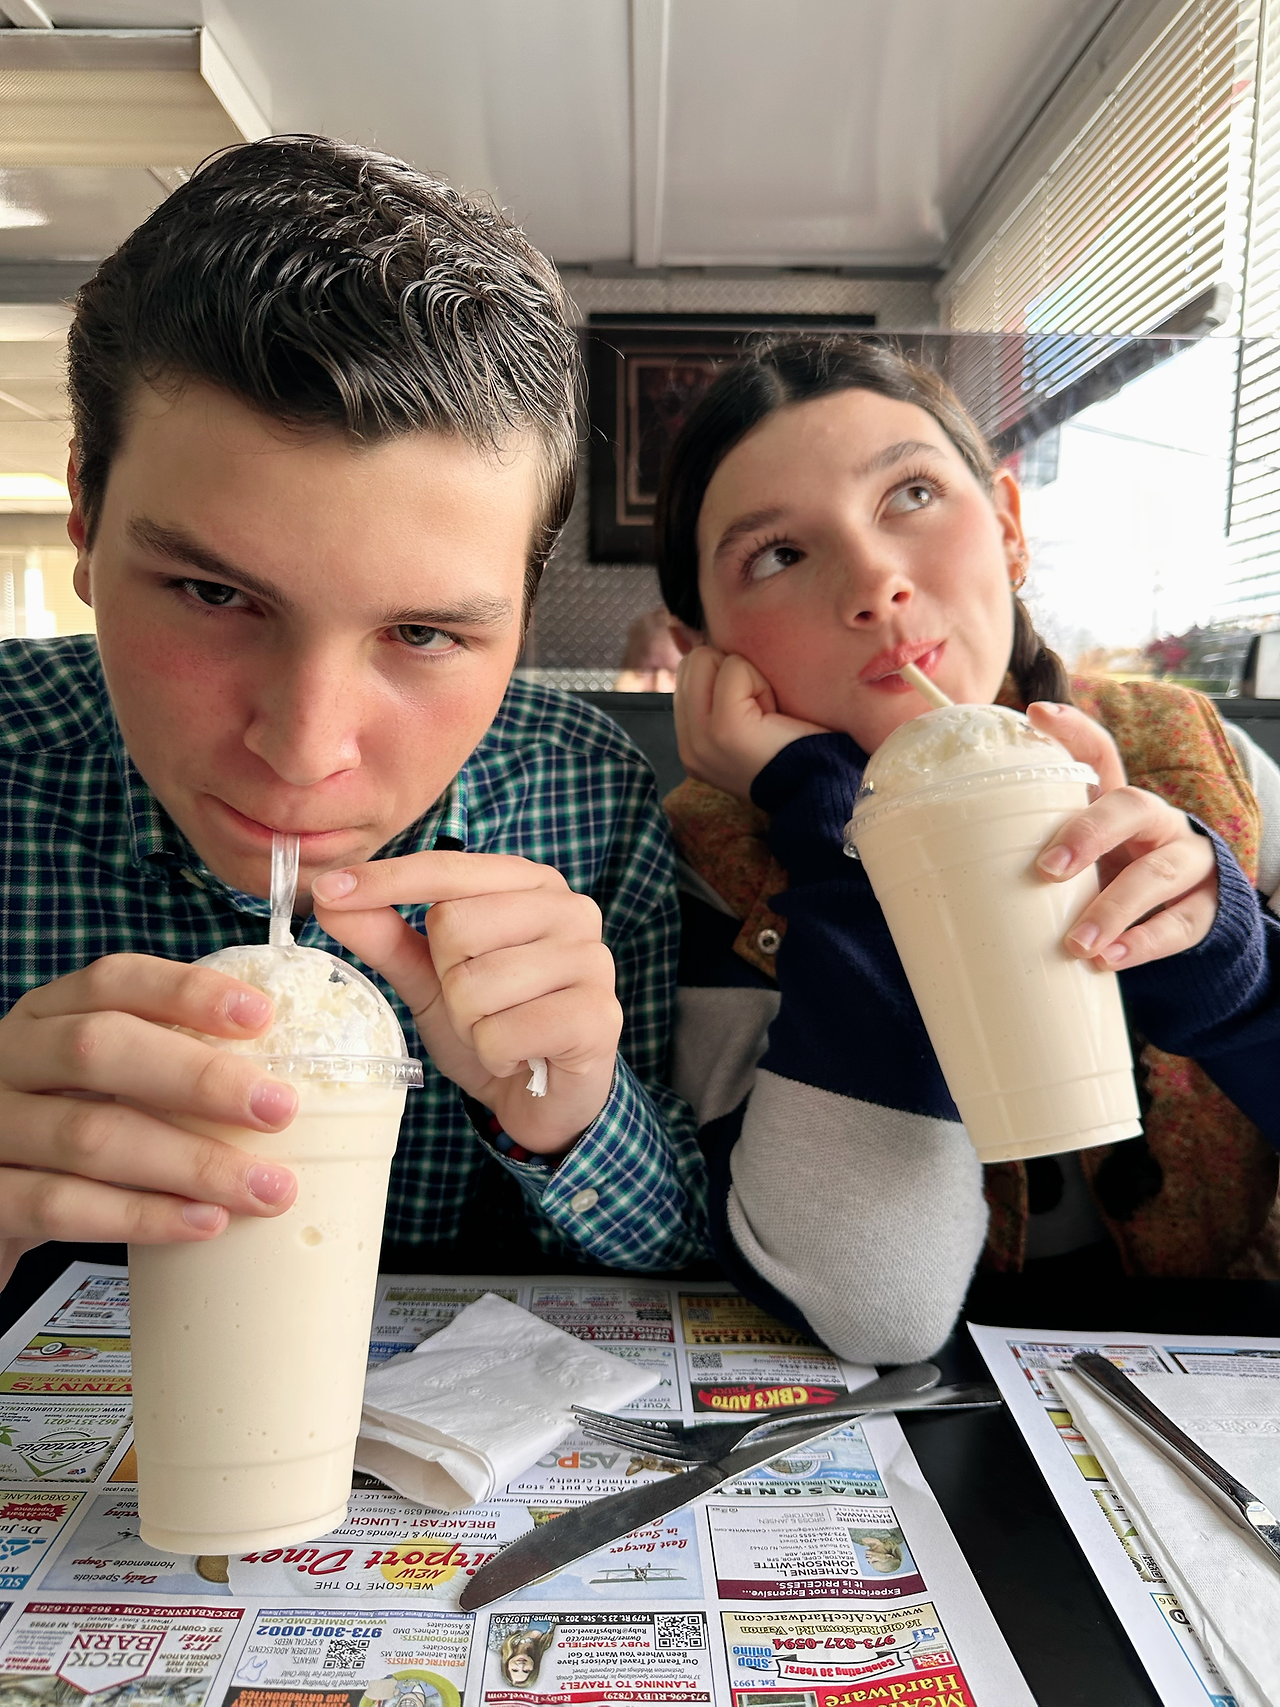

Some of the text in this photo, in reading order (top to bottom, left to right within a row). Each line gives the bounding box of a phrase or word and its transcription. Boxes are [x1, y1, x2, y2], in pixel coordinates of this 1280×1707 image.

[10, 1382, 132, 1392] VINNY'S
[711, 1386, 808, 1410] CBK'S AUTO
[11, 1441, 110, 1457] Cannabis
[712, 1486, 878, 1496] MASONRY
[350, 1517, 496, 1528] BREAKFAST LUNCH
[21, 1526, 42, 1534] Dr.
[367, 1530, 409, 1538] Friends
[422, 1530, 459, 1539] Family
[667, 1528, 678, 1536] in
[462, 1532, 497, 1540] Where
[610, 1539, 688, 1554] Best Burger
[71, 1556, 175, 1569] Homemade Soups
[240, 1543, 494, 1576] irport Diner
[753, 1560, 855, 1569] JOHNSON-WITTE
[394, 1568, 446, 1579] NEW
[790, 1568, 858, 1576] CATHERINE
[73, 1571, 158, 1584] Daily Specials
[314, 1582, 434, 1591] WELCOME TO THE
[776, 1580, 840, 1589] PRICELESS.
[742, 1589, 805, 1598] Expensive...
[842, 1588, 900, 1596] Experience
[32, 1604, 239, 1617] DECKBARNNJ2.COM 862-351-6262
[733, 1607, 923, 1623] www.McAfeeHardware.com
[262, 1618, 387, 1626] www.DRMIKEDMD.com
[532, 1614, 560, 1622] Wayne,
[256, 1626, 383, 1638] 973-300-0002
[740, 1626, 816, 1635] Rd Vernon
[70, 1634, 158, 1651] BARN
[178, 1634, 222, 1642] TIME!
[400, 1635, 469, 1643] ORTHODONTISTS:
[772, 1635, 896, 1650] 973-827-0594
[182, 1642, 213, 1651] IT'S
[248, 1645, 321, 1655] CHILDREN, ADOLESCENTS
[422, 1644, 461, 1652] Associates
[732, 1647, 772, 1657] Online
[67, 1652, 150, 1668] DECK
[292, 1656, 318, 1664] INFANTS,
[384, 1657, 465, 1667] PEDIATRIC DENTISTS:
[738, 1657, 769, 1668] Shop
[784, 1659, 895, 1677] Celebrating 30 Years!
[560, 1681, 612, 1690] TRAVEL?
[616, 1680, 632, 1688] TO
[825, 1674, 960, 1707] Hardware
[325, 1693, 349, 1702] AND
[487, 1692, 571, 1703] RubysTravel.com
[603, 1691, 708, 1700] 973-696-RUBY (7829)
